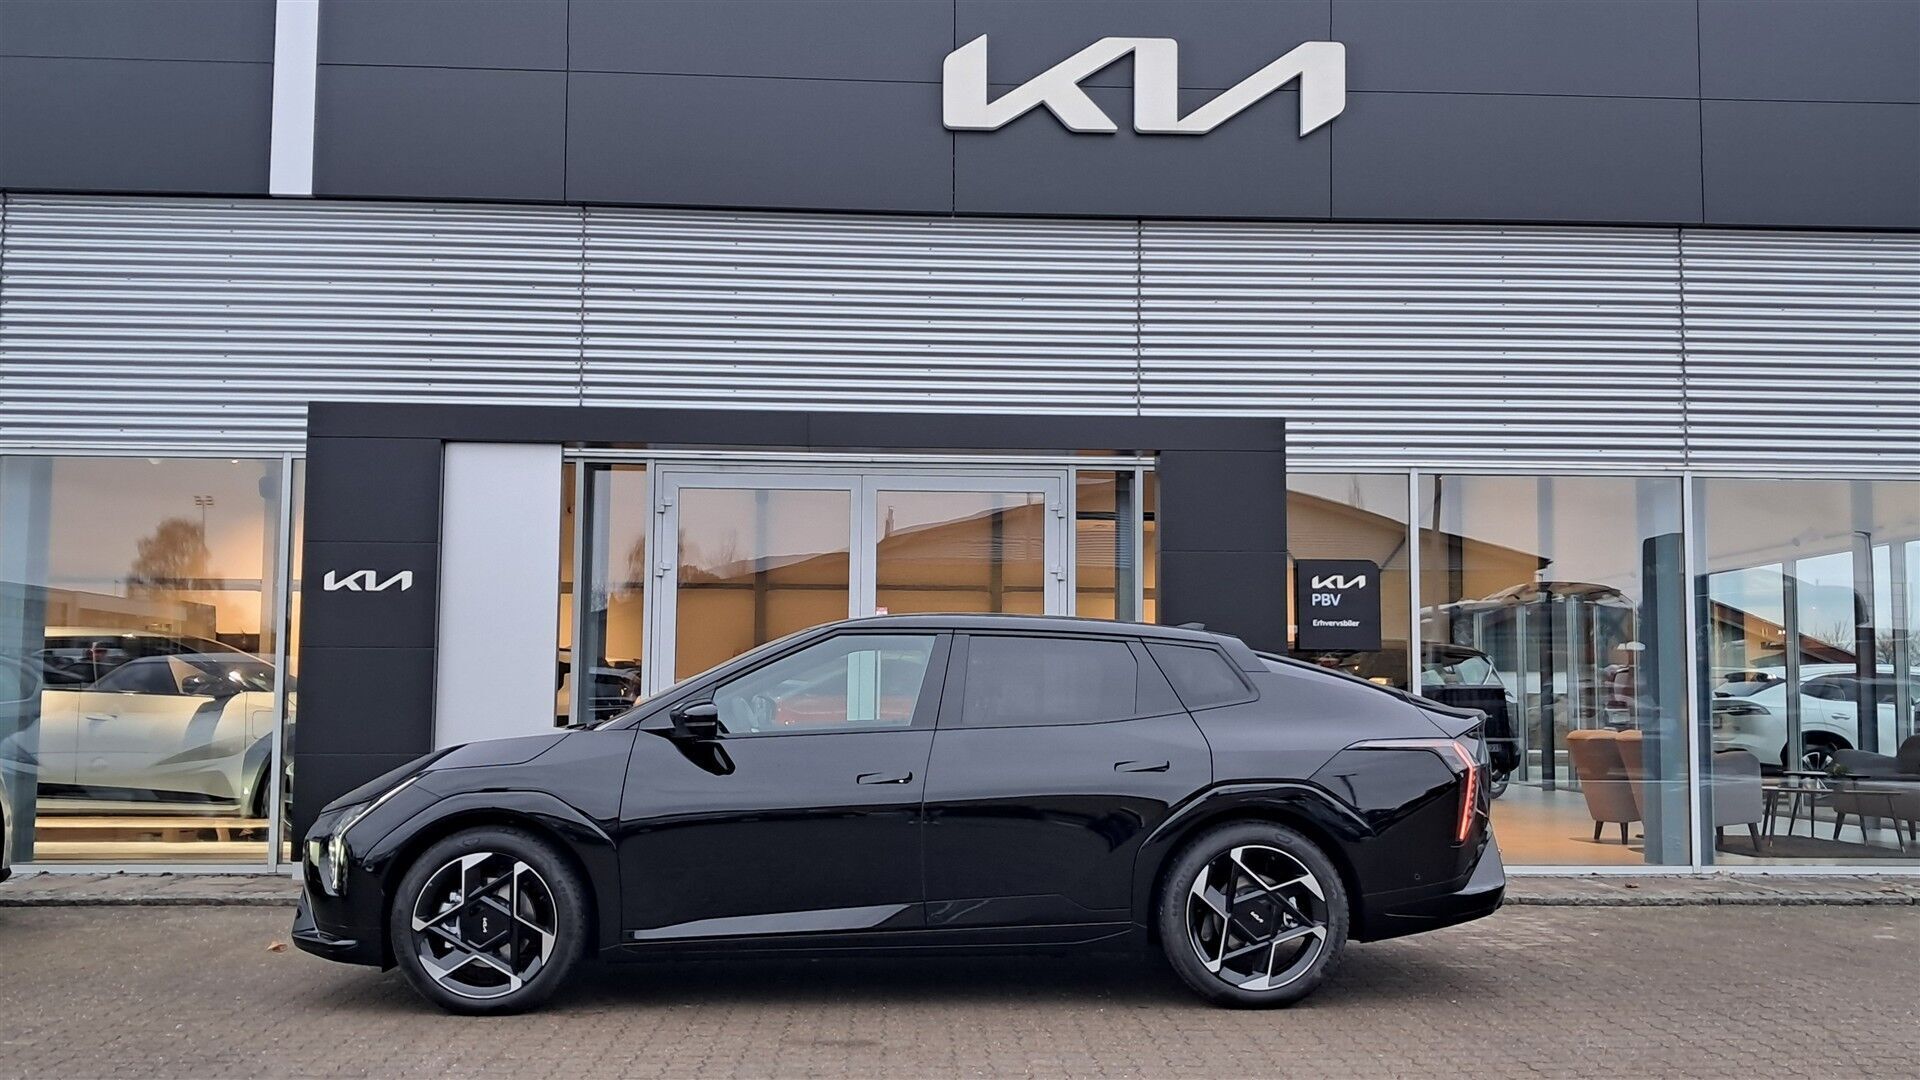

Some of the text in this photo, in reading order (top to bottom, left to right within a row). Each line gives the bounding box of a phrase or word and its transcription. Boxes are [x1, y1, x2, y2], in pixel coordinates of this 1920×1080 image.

[943, 33, 1346, 137] KIA
[323, 570, 413, 592] KIA
[1311, 575, 1366, 589] KIA
[1311, 593, 1341, 606] PBV
[1312, 619, 1360, 627] Erhvervsbiler
